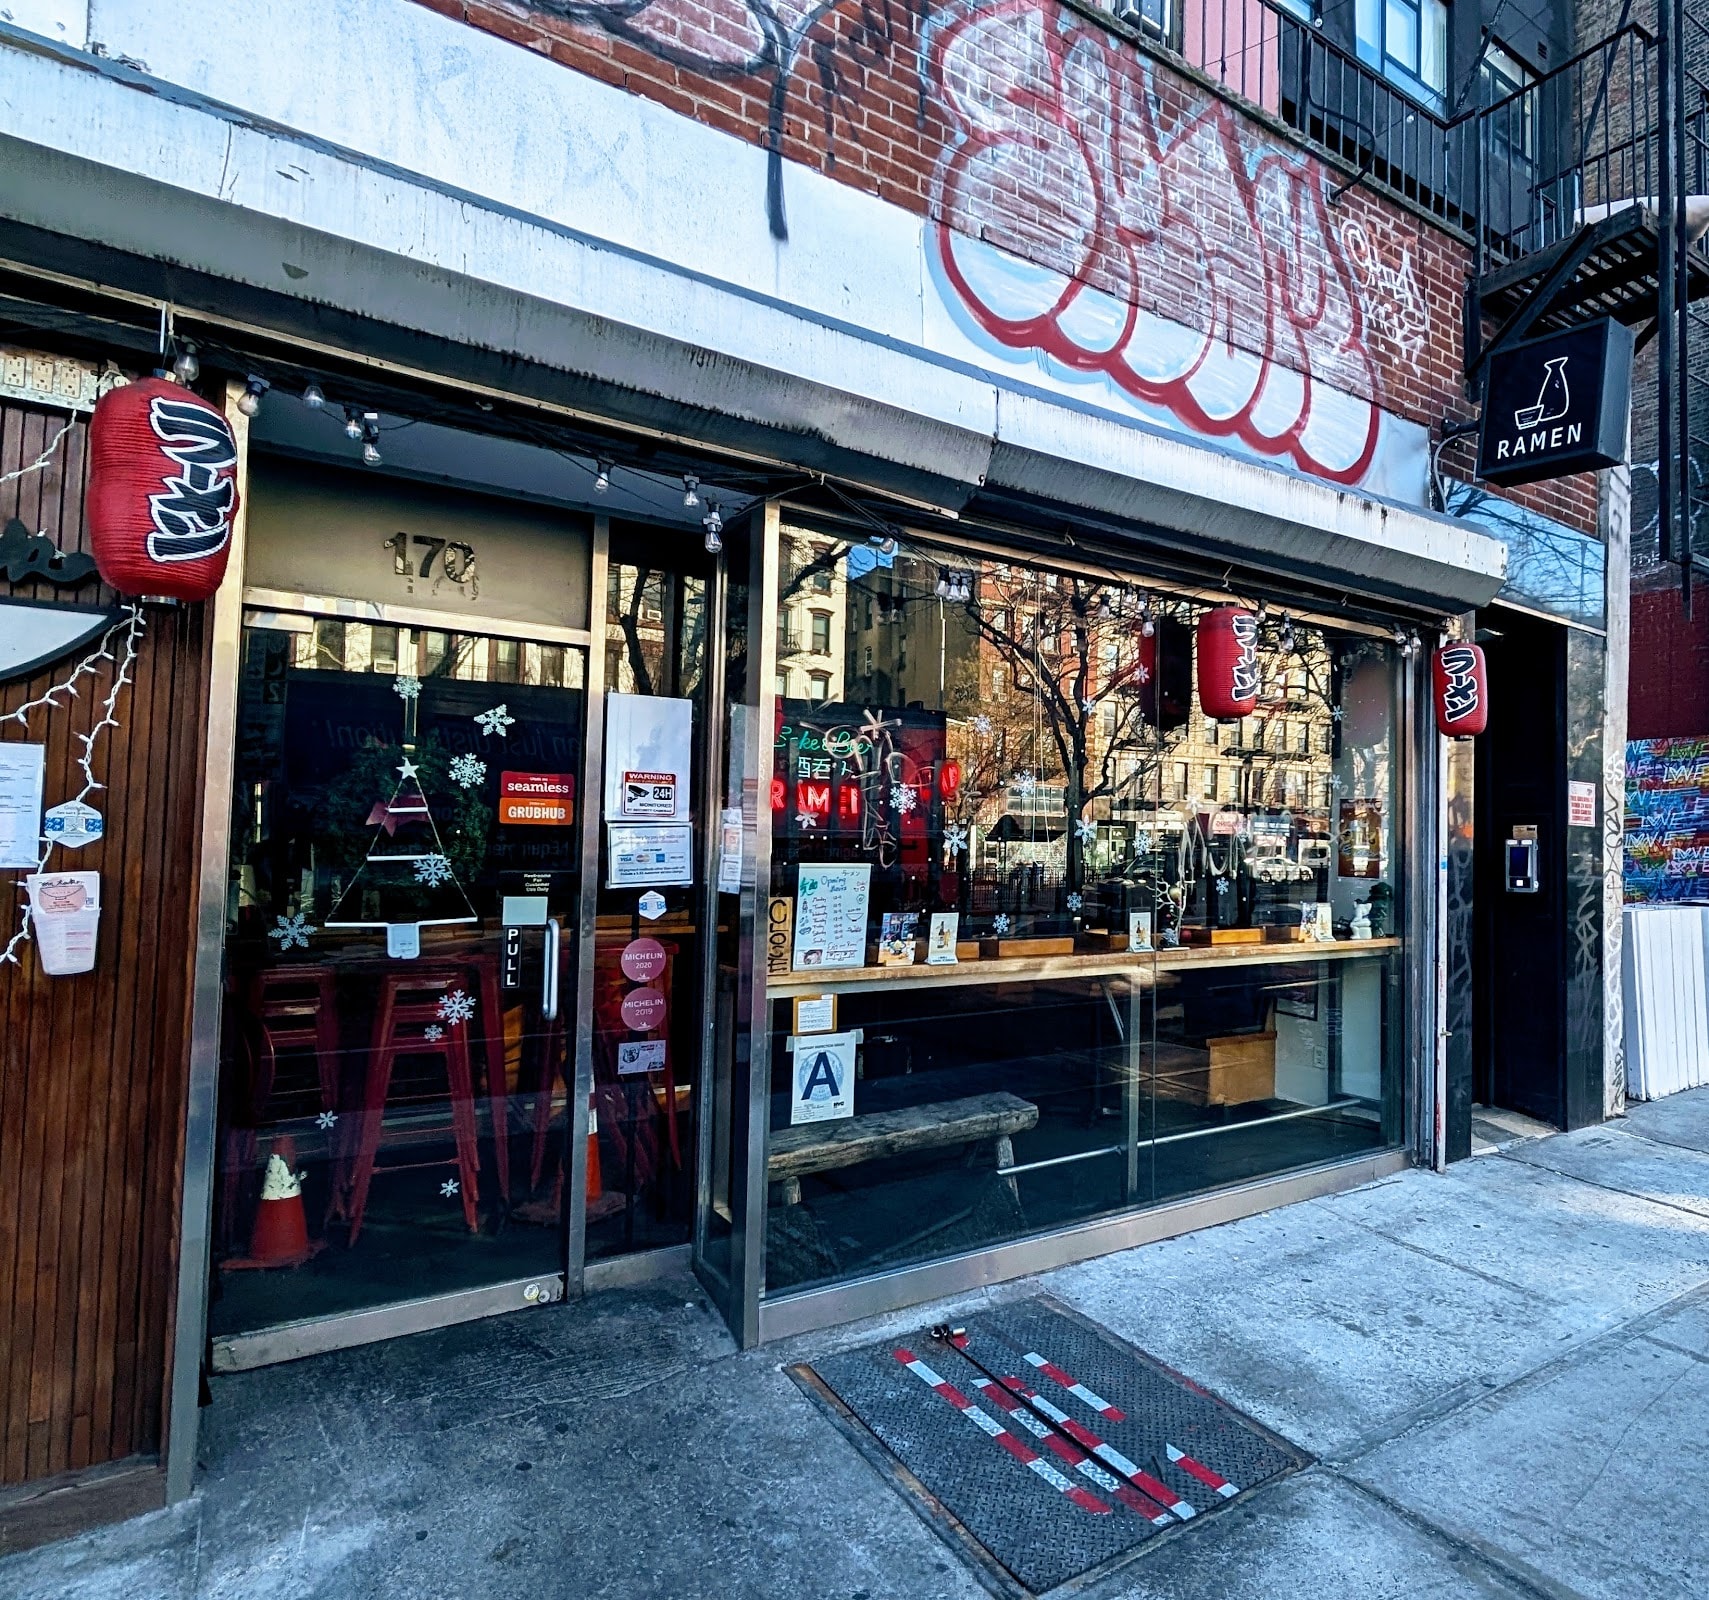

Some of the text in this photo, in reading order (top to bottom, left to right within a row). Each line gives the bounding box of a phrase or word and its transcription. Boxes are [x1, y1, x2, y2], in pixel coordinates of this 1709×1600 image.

[1497, 422, 1582, 460] RAMEN
[147, 396, 237, 563] ラーメン
[384, 532, 475, 584] 170
[1441, 647, 1479, 723] ラーメン
[628, 773, 673, 781] WARNING
[1663, 763, 1706, 783] LOVE
[507, 782, 569, 793] seamless
[653, 787, 672, 799] 24H
[508, 806, 566, 819] GRUBHUB
[507, 929, 519, 986] PULL
[624, 953, 663, 961] MICHELIN
[624, 998, 664, 1009] MICHELIN
[635, 1007, 653, 1016] 2019
[800, 1052, 840, 1100] A
